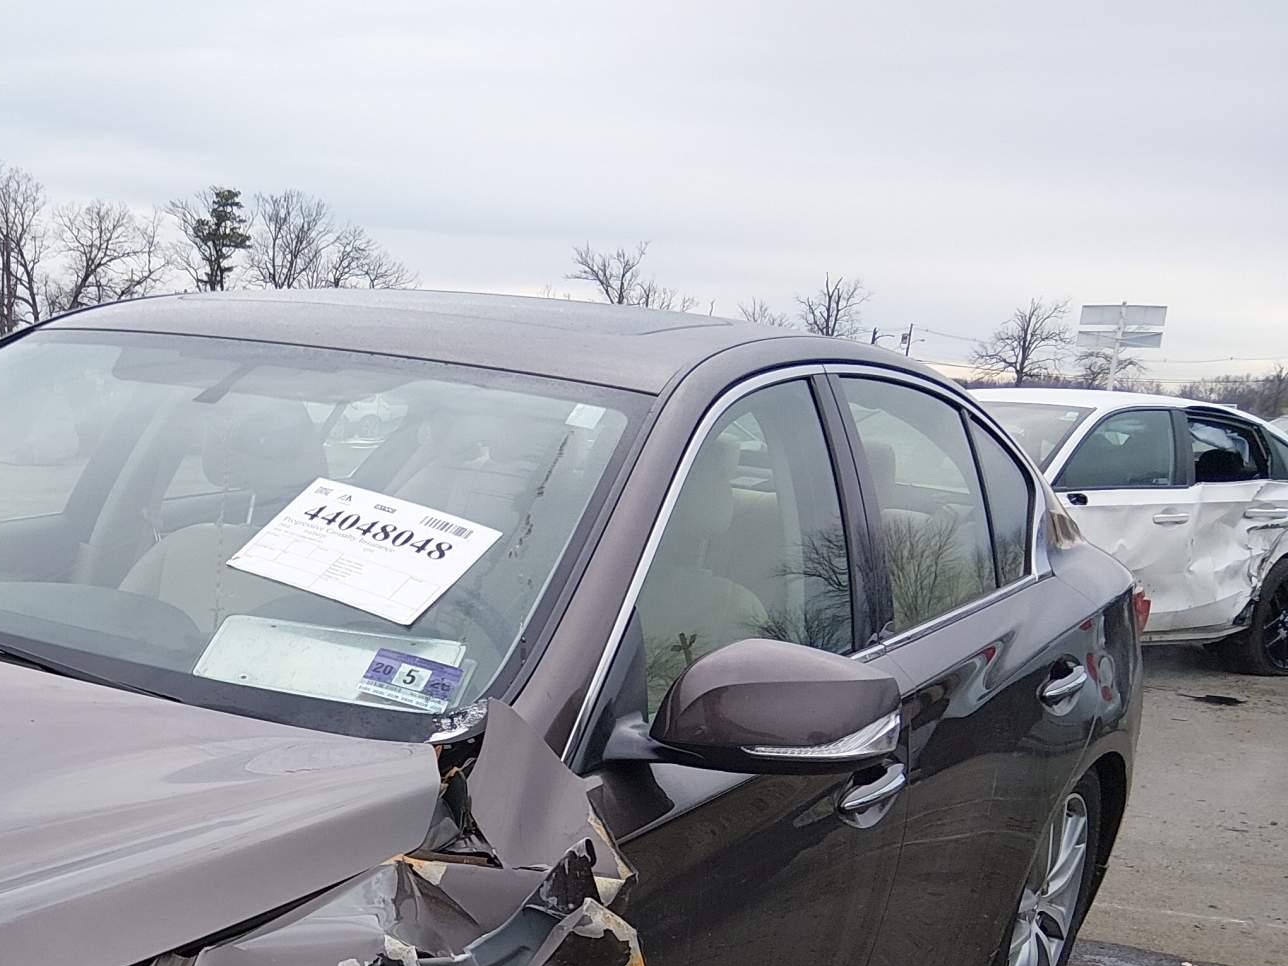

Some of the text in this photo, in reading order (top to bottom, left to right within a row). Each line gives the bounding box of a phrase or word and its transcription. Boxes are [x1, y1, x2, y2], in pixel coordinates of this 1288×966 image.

[303, 504, 454, 560] 44048048
[371, 662, 394, 676] 20
[402, 668, 420, 685] 5
